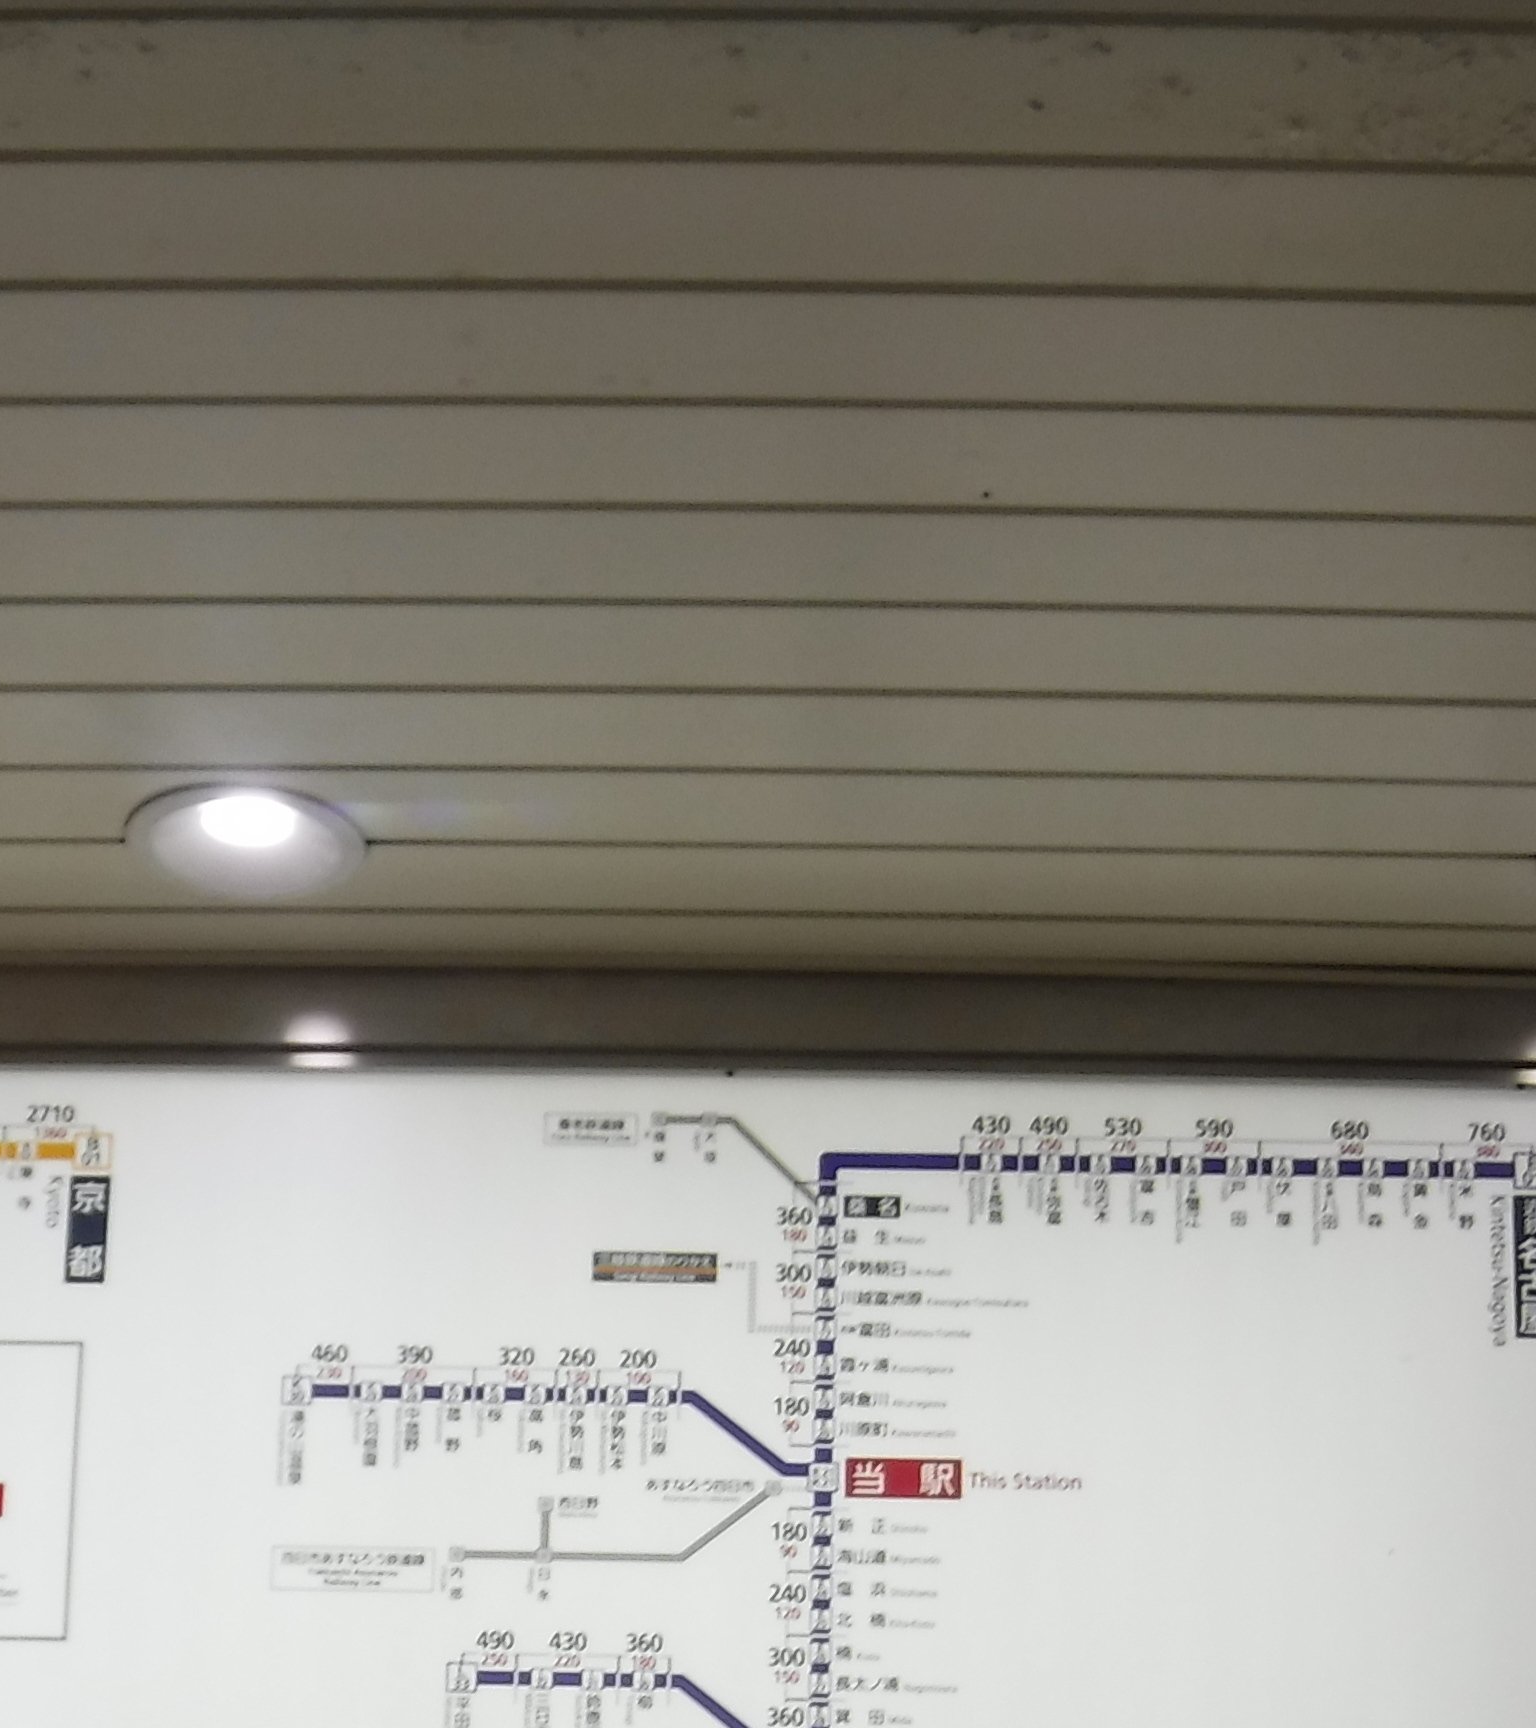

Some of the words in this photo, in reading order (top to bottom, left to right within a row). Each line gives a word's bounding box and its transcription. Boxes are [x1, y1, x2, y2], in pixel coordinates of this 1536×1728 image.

[27, 1105, 74, 1123] 2710
[972, 1115, 1012, 1135] 430
[1029, 1115, 1068, 1135] 490
[1196, 1118, 1233, 1138] 590
[1467, 1123, 1506, 1142] 760
[776, 1207, 812, 1226] 360
[69, 1182, 105, 1277] 京都
[311, 1344, 349, 1362] 460
[559, 1348, 596, 1366] 260
[619, 1350, 656, 1367] 200
[775, 1397, 809, 1417] 180
[851, 1461, 956, 1496] 当駅
[969, 1472, 1007, 1490] This
[1013, 1473, 1082, 1492] Station
[772, 1522, 807, 1541] 180
[626, 1634, 662, 1651] 360
[768, 1707, 804, 1726] 360
